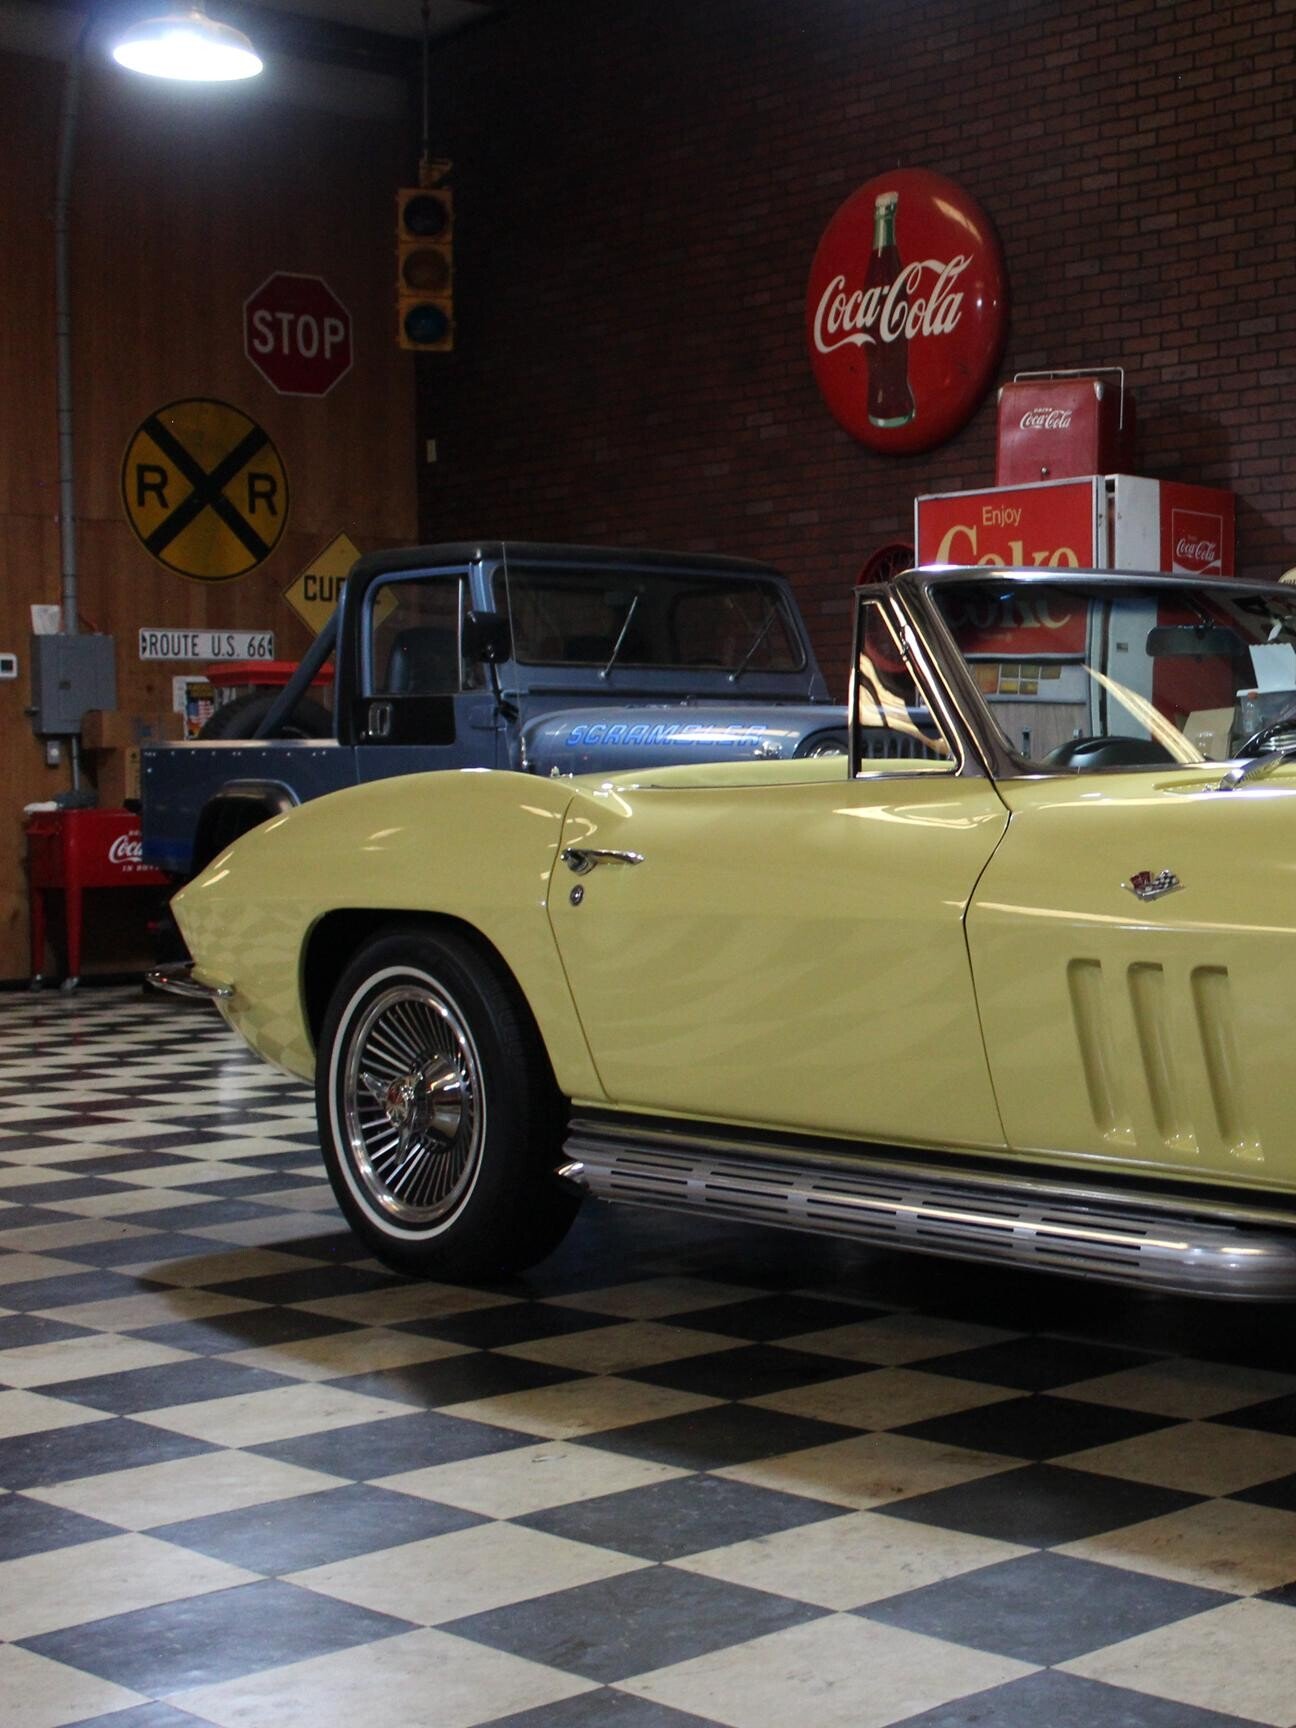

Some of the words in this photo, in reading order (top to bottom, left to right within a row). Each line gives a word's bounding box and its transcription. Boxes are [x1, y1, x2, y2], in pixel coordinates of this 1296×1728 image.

[813, 254, 974, 354] Coca-Cola
[252, 309, 345, 360] STOP
[1019, 409, 1072, 430] Coca-Cola
[136, 463, 169, 509] R
[247, 472, 278, 516] R
[982, 505, 1022, 528] Enjoy
[1176, 537, 1217, 561] Coca-Cola
[149, 633, 199, 657] ROUTE
[211, 635, 240, 657] U.S.
[247, 636, 266, 658] 66
[565, 723, 769, 747] SCRAMBLER
